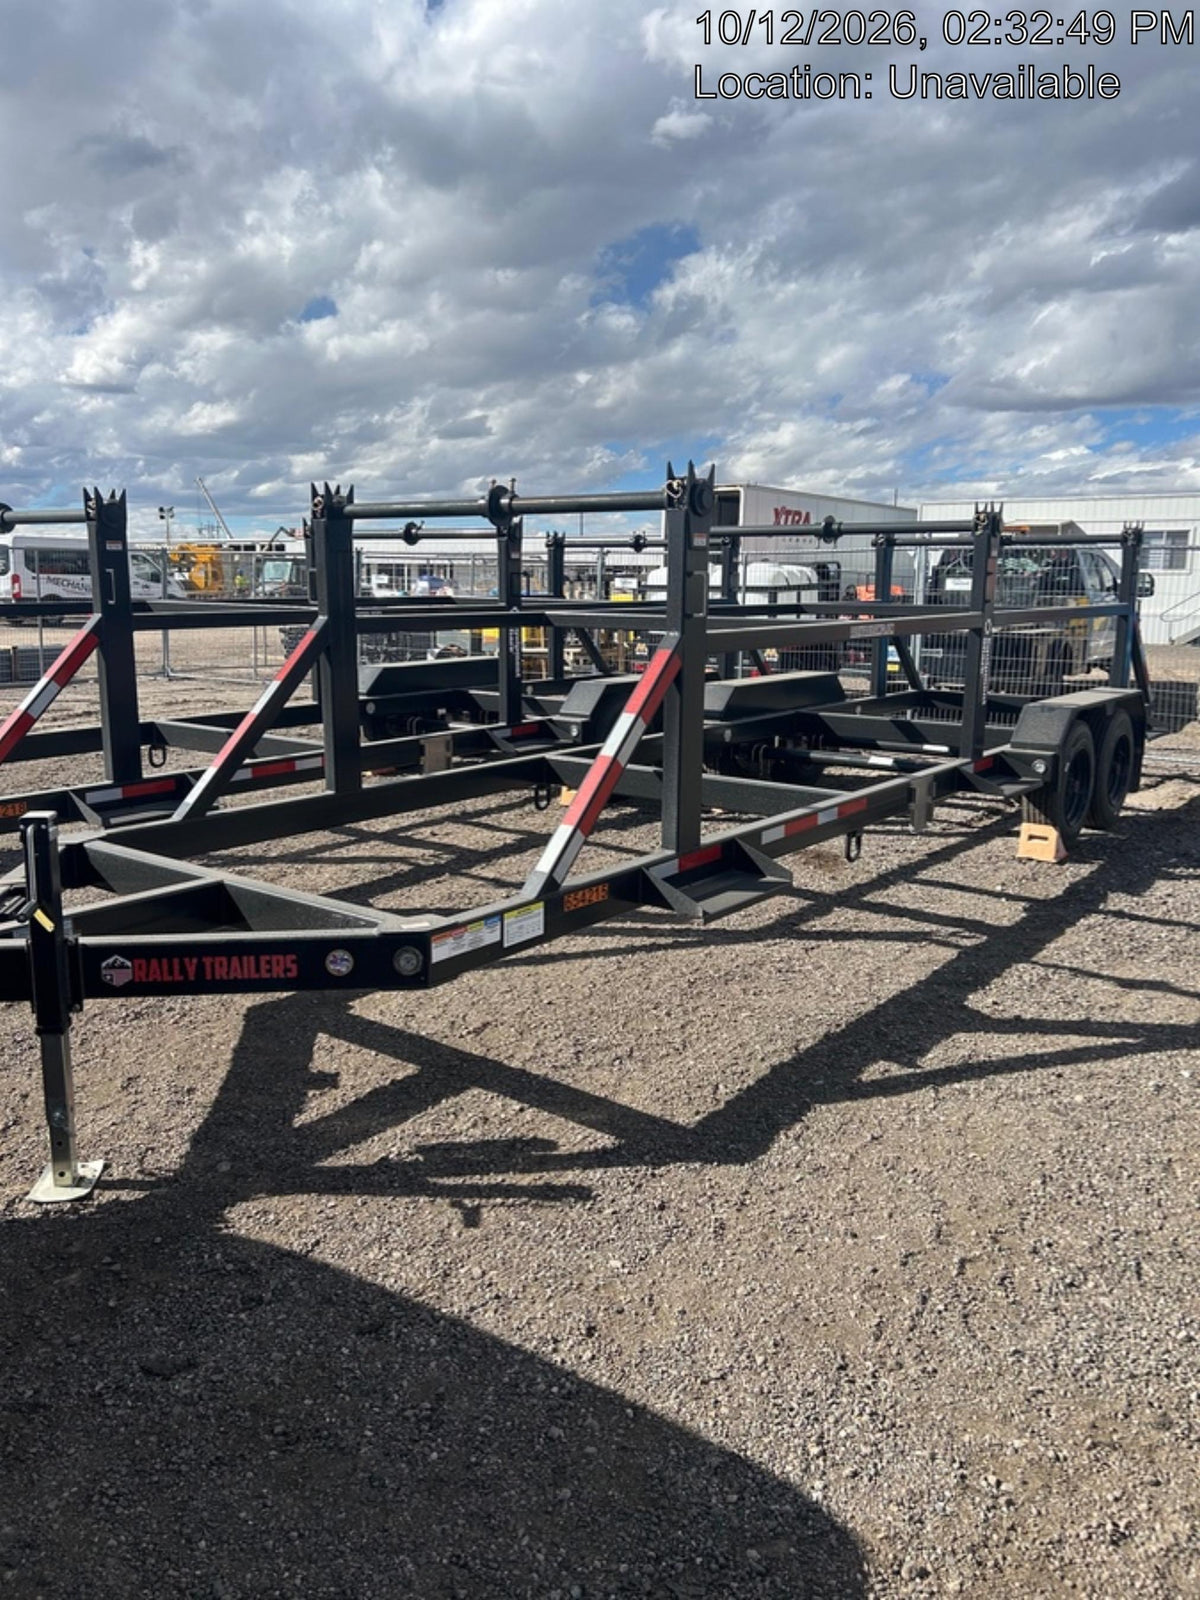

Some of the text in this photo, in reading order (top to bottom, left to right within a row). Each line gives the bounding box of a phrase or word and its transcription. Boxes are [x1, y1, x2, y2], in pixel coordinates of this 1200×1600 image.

[773, 506, 811, 527] XTRA
[132, 954, 298, 982] RALLY TRAILERS
